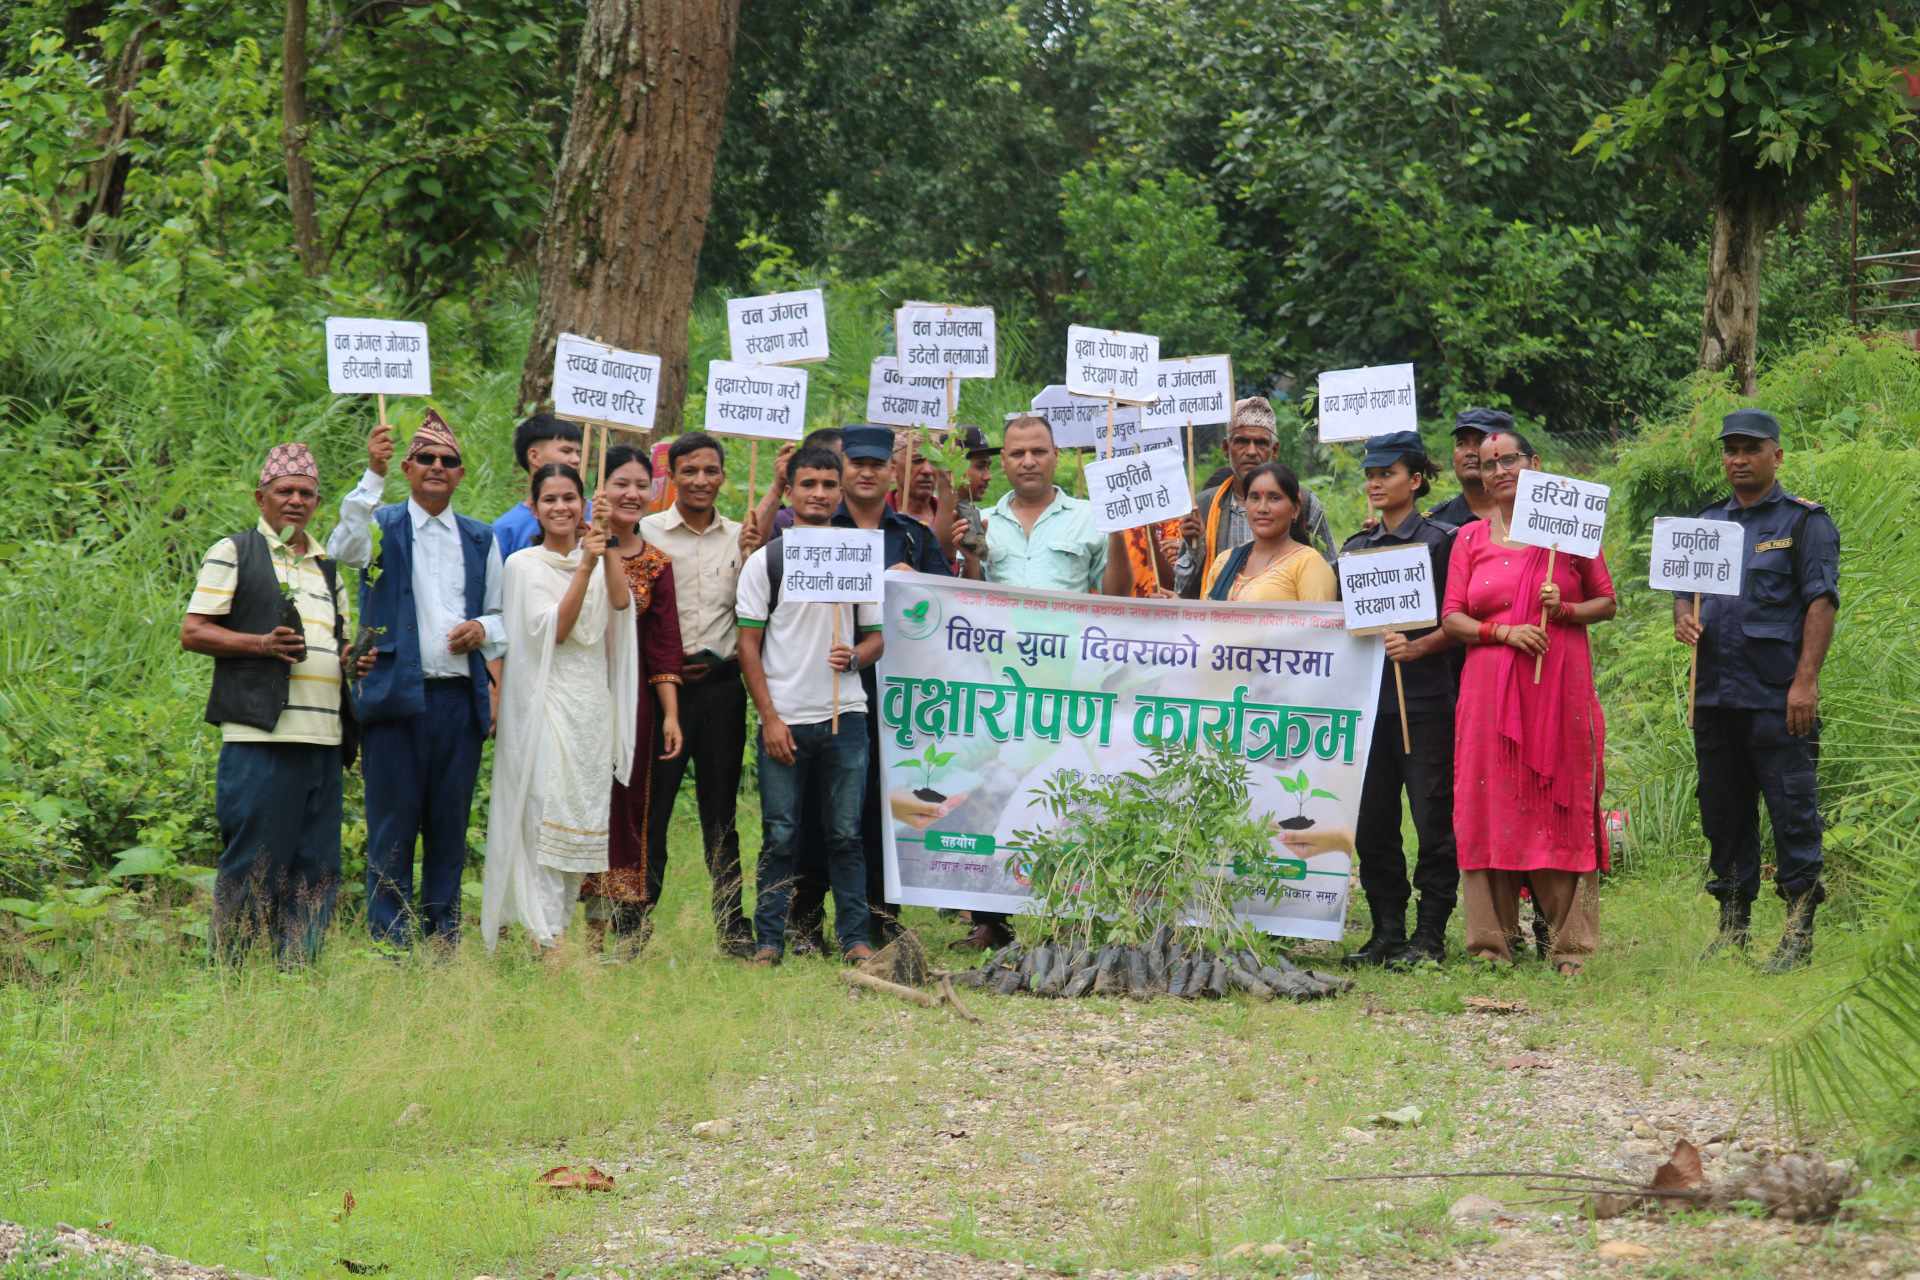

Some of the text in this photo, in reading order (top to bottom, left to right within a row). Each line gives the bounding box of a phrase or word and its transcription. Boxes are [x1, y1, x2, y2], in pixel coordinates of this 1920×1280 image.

[741, 302, 808, 325] वन जंगल
[913, 318, 982, 337] वन जंगलमा
[334, 334, 350, 350] वन
[352, 331, 382, 352] जंगल
[745, 334, 785, 354] संरक्षण
[1075, 339, 1096, 359] वृक्षा
[1099, 337, 1127, 359] रोपण
[342, 356, 382, 379] हरियाली
[567, 353, 653, 384] स्वच्छ वातावरण
[1080, 362, 1117, 384] संरक्षण
[1171, 369, 1216, 388] जंगलमा
[714, 376, 773, 396] वृक्षारोपण
[572, 386, 646, 415] स्वस्थ शरिर
[718, 401, 763, 421] संरक्षण
[882, 394, 919, 414] संरक्षण
[1105, 494, 1132, 520] हाम्रो
[1155, 484, 1171, 508] हो
[1531, 481, 1609, 513] हरियो वन
[1528, 508, 1579, 537] नेपालको
[1672, 527, 1720, 555] प्रकृतिनै
[785, 545, 800, 560] वन
[1663, 555, 1689, 578] हाम्रो
[1717, 558, 1731, 581] हो
[786, 570, 834, 591] हरियाली
[1345, 567, 1401, 594] वृक्षारोपण
[1353, 597, 1396, 616] संरक्षण
[946, 616, 1334, 678] विश्व युवा दिवसको अवसरमा
[883, 666, 1363, 765] वृक्षारोपण कार्यक्रम
[940, 834, 977, 850] सहयोग
